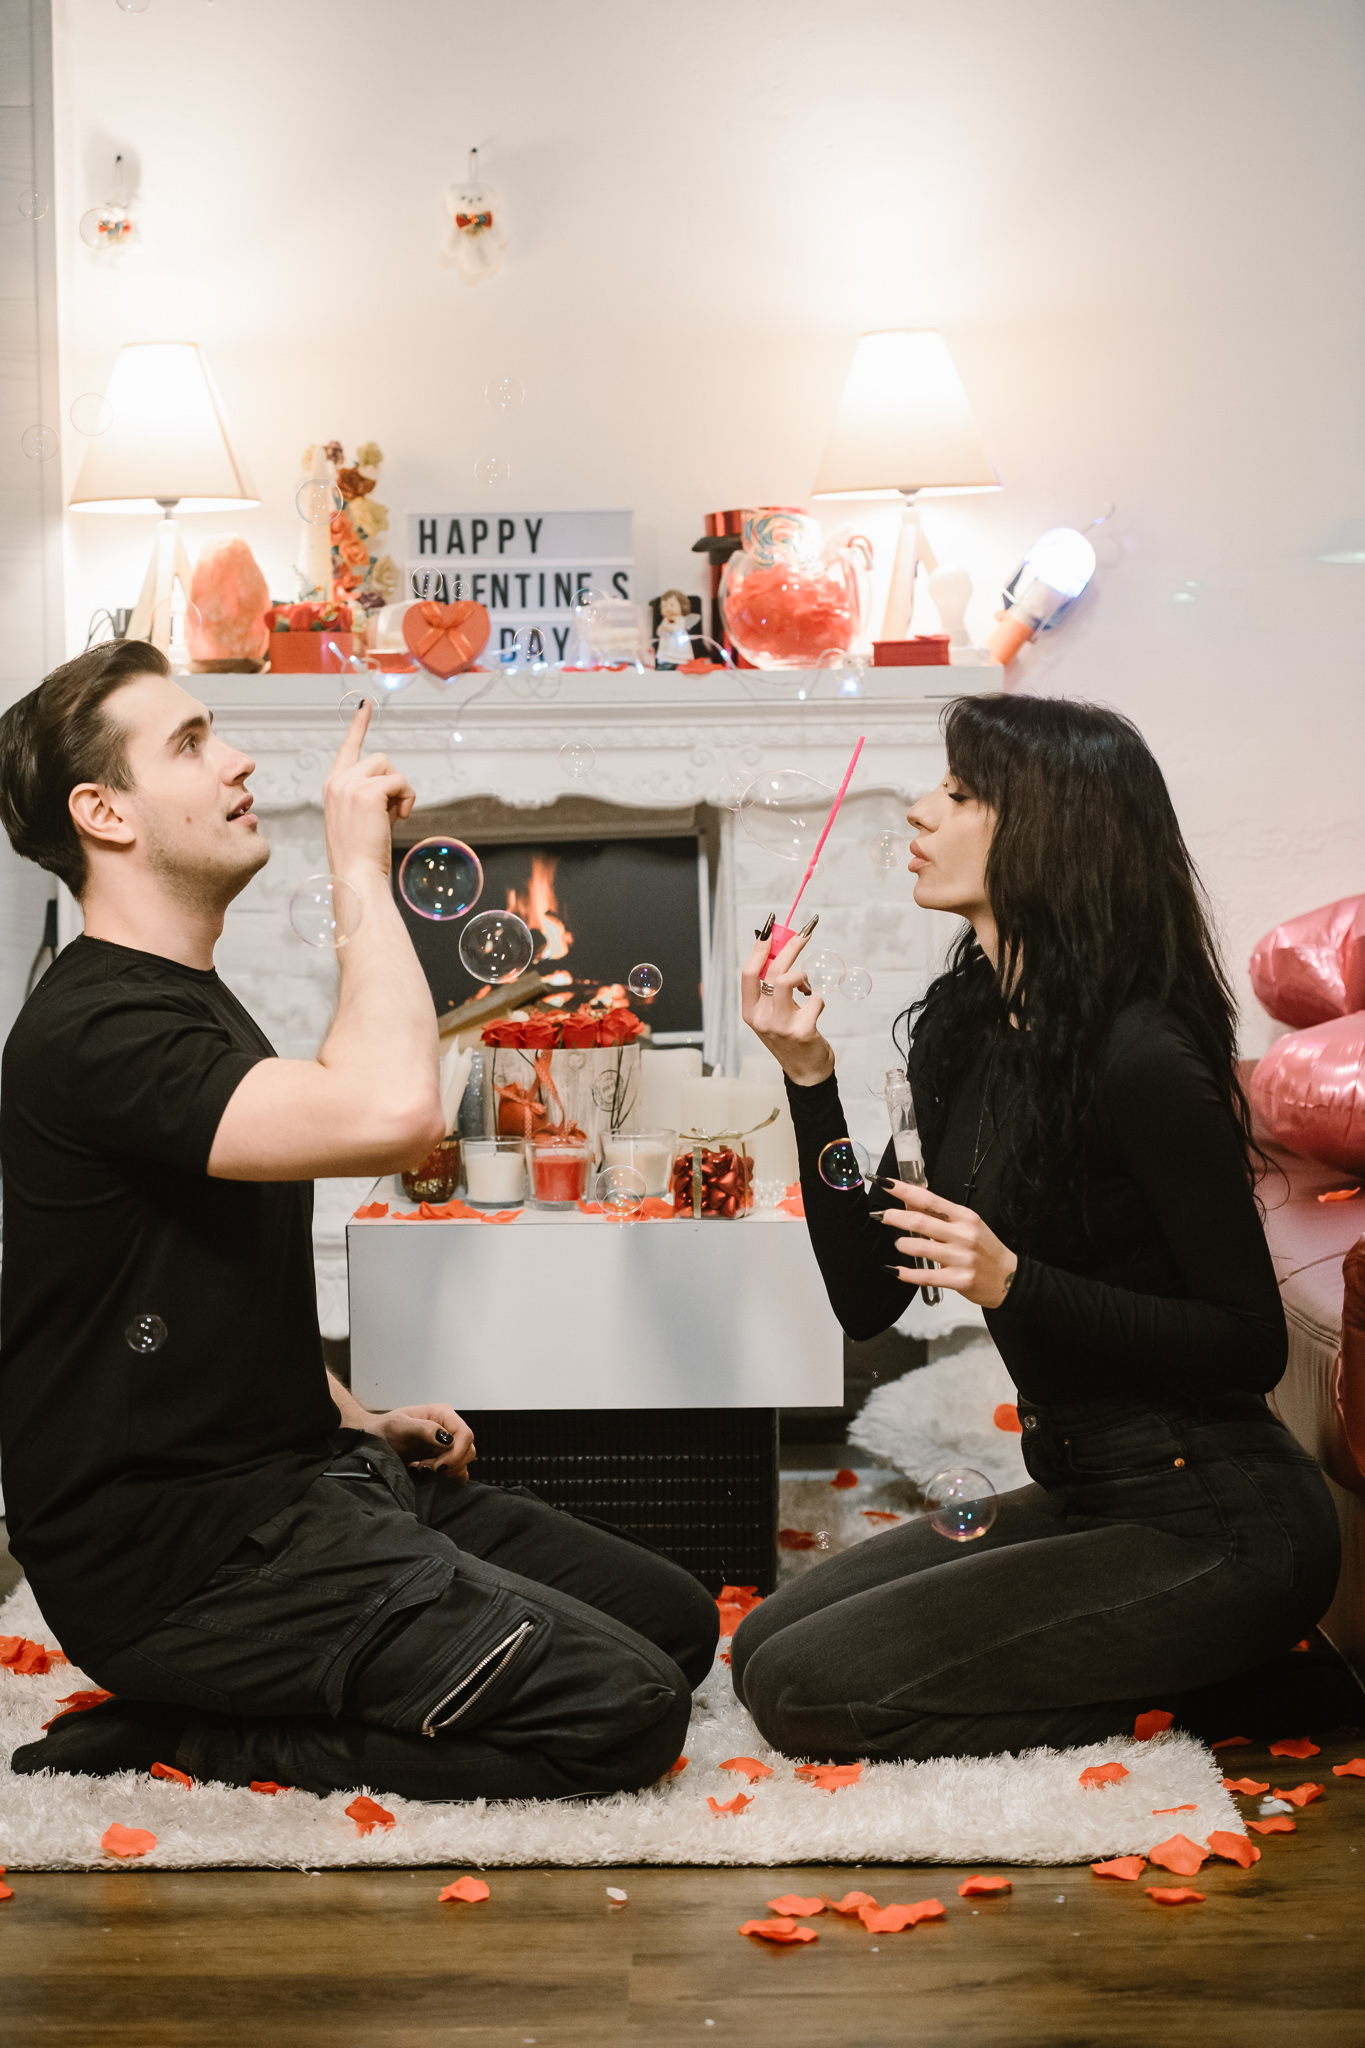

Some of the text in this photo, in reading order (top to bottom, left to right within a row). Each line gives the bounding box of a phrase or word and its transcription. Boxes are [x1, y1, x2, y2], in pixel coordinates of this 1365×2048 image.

[419, 518, 543, 555] HAPPY
[412, 572, 592, 608] VALENTINE
[500, 627, 571, 663] DAY
